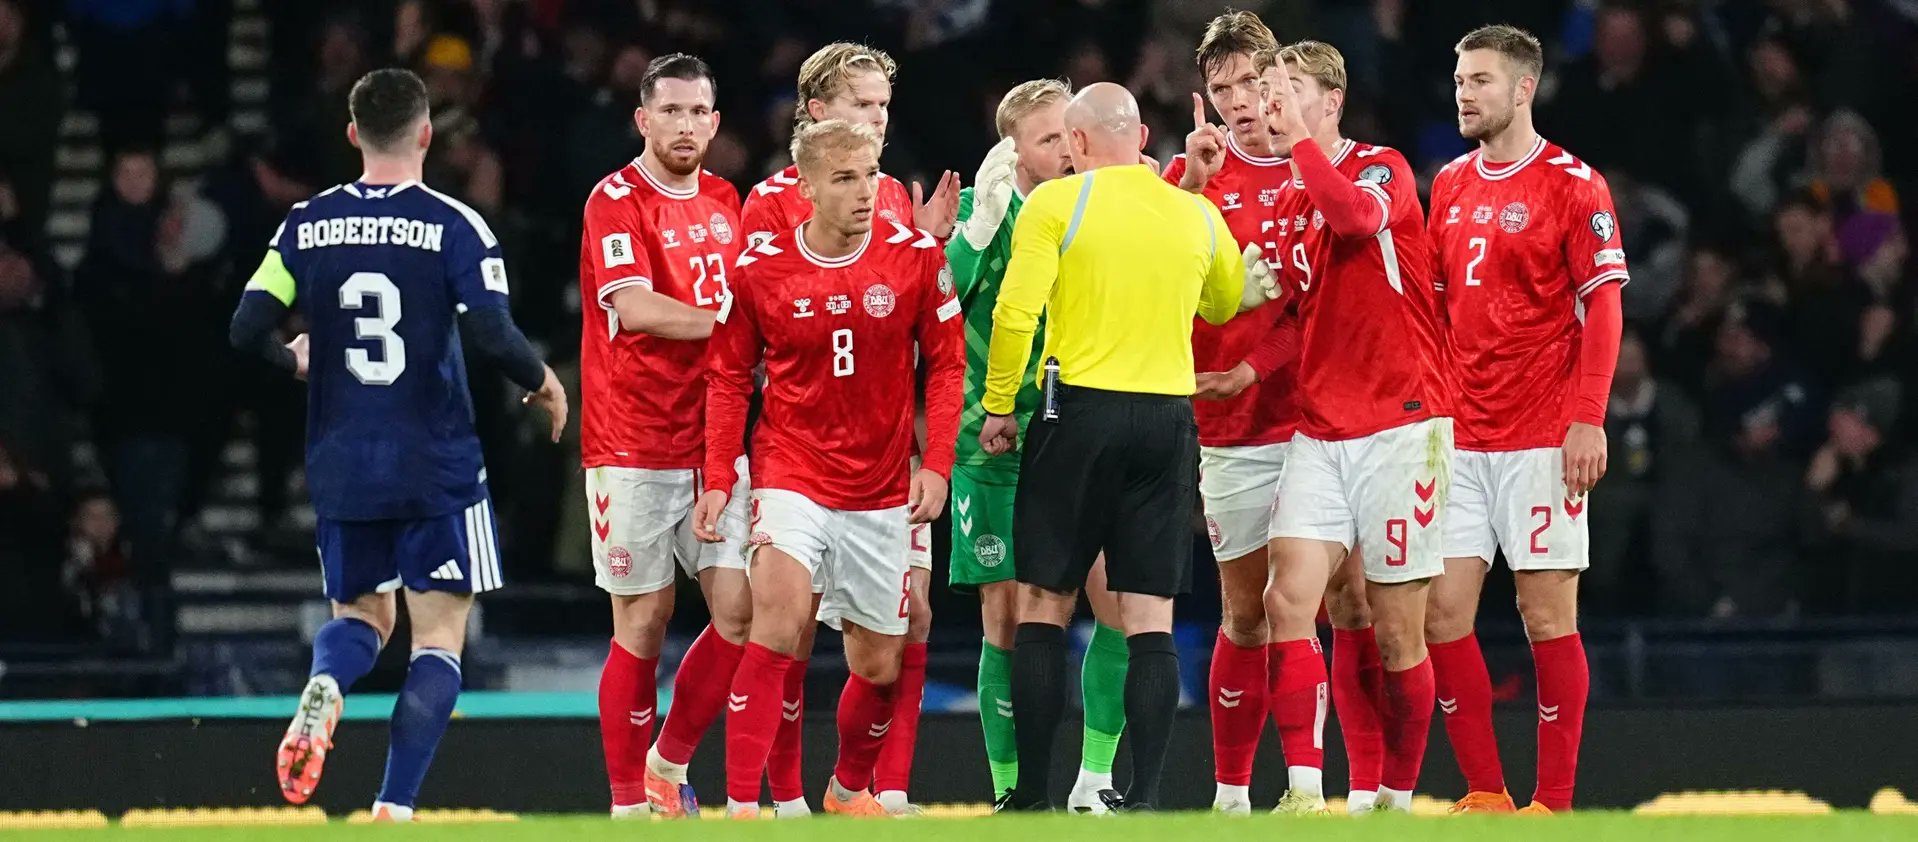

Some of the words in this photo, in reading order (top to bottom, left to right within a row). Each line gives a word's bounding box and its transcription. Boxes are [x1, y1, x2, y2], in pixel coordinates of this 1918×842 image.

[298, 216, 444, 252] ROBERTSON
[689, 253, 730, 306] 23
[1293, 243, 1312, 291] 9
[1466, 237, 1487, 286] 2
[339, 271, 406, 386] 3
[832, 328, 854, 378] 8
[1386, 519, 1408, 567] 9
[1531, 506, 1552, 554] 2
